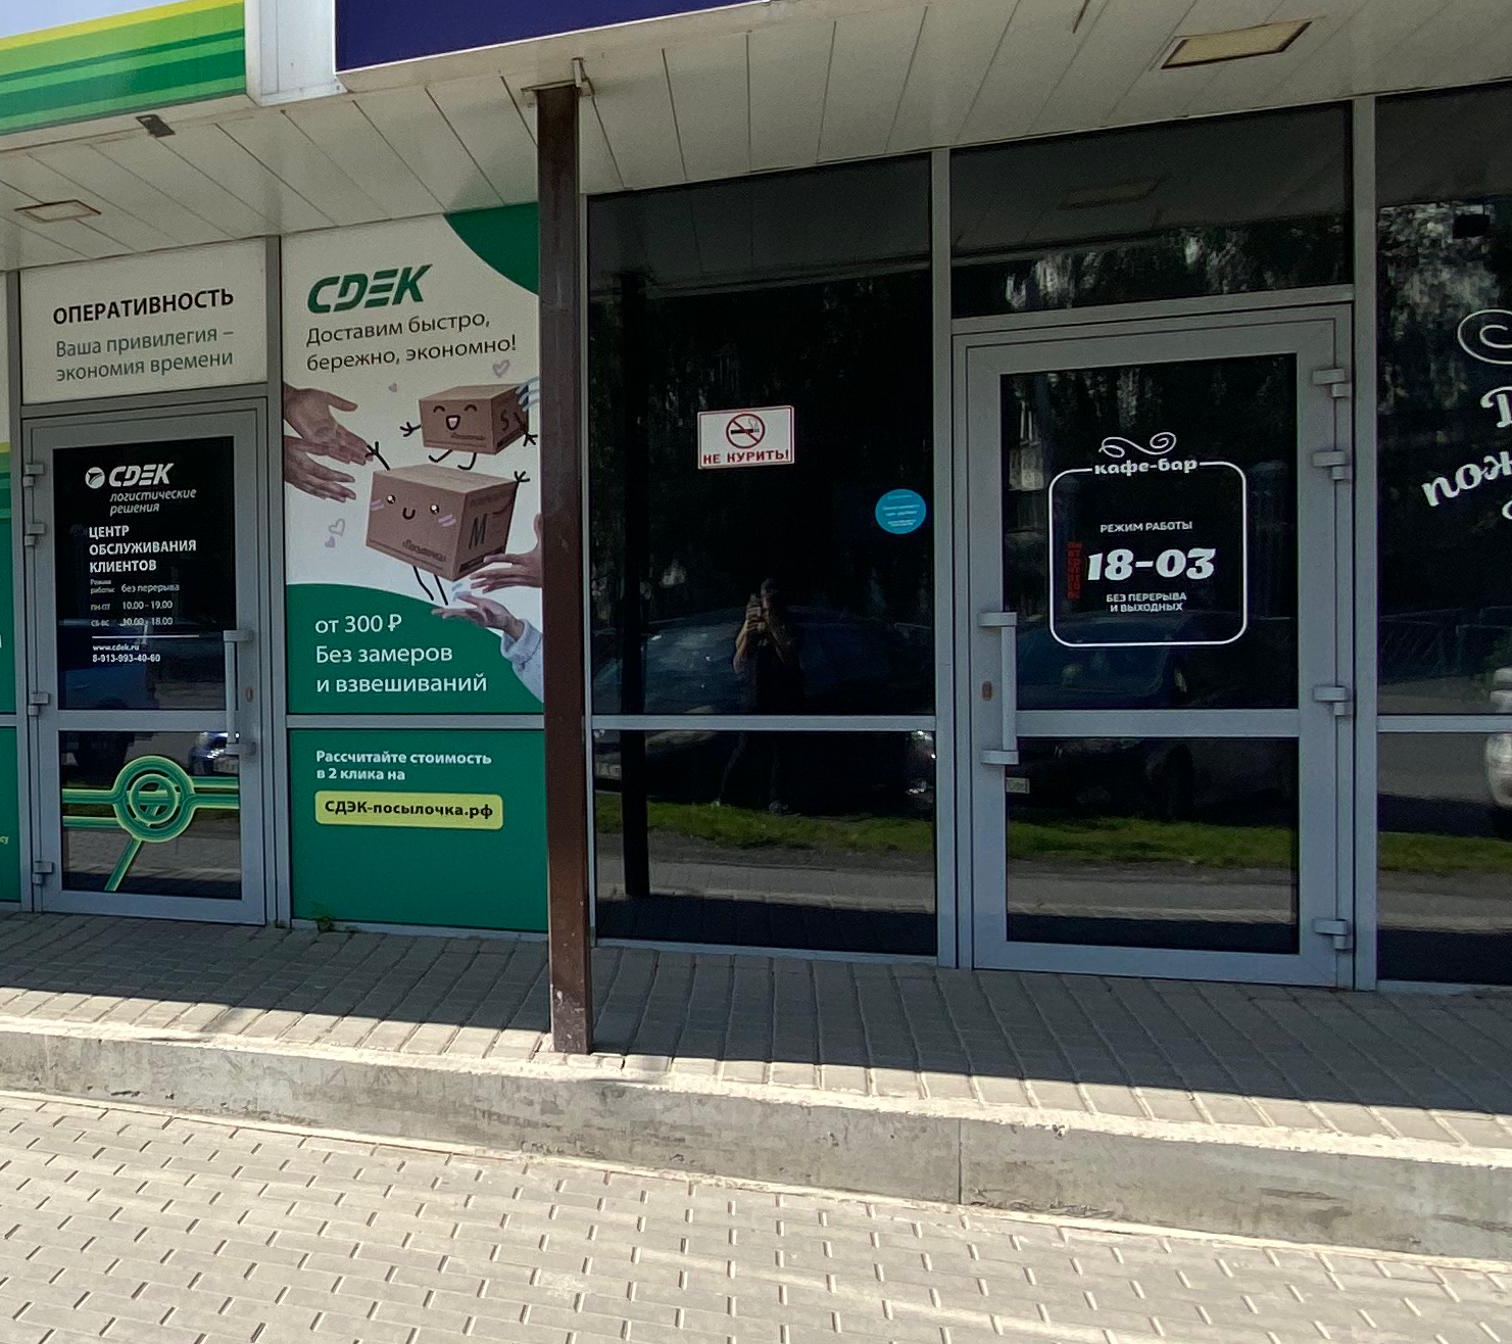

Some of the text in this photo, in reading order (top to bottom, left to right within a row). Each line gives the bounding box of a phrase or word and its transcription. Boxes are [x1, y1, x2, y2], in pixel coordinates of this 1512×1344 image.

[307, 264, 433, 314] CDEK
[53, 288, 234, 324] ОПЕРАТИВНОСТЬ
[306, 313, 490, 347] Доставим быстро,
[56, 340, 101, 357] Ваша
[106, 328, 217, 355] привилегия
[306, 334, 517, 373] бережно, экономно!
[56, 352, 233, 381] экономия времени
[703, 448, 789, 465] НЕ КУРИТЬ!
[109, 463, 174, 487] CDEK
[1094, 458, 1199, 477] кафе-бар
[109, 489, 197, 502] логистические
[109, 503, 160, 517] решения
[88, 525, 129, 540] ЦЕНТР
[1099, 521, 1193, 533] РЕЖИМ РАБОТЫ
[89, 539, 197, 555] ОБСЛУЖИВАНИЯ
[89, 559, 157, 573] КЛИЕНТОВ
[1088, 547, 1217, 581] 18-03
[121, 584, 180, 593] без перерыва
[1106, 592, 1187, 603] БЕЗ ПЕРЕРЫВА
[1110, 603, 1183, 613] И ВЫХОДНЫХ
[315, 620, 339, 633] от
[344, 615, 383, 633] 300
[316, 645, 453, 666] Без замеров
[316, 672, 487, 693] и взвешиваний
[316, 750, 492, 765] Рассчитайте стоимость
[316, 768, 406, 780] в 2 клика на
[324, 800, 493, 819] СДЭК-посылочка.рф
